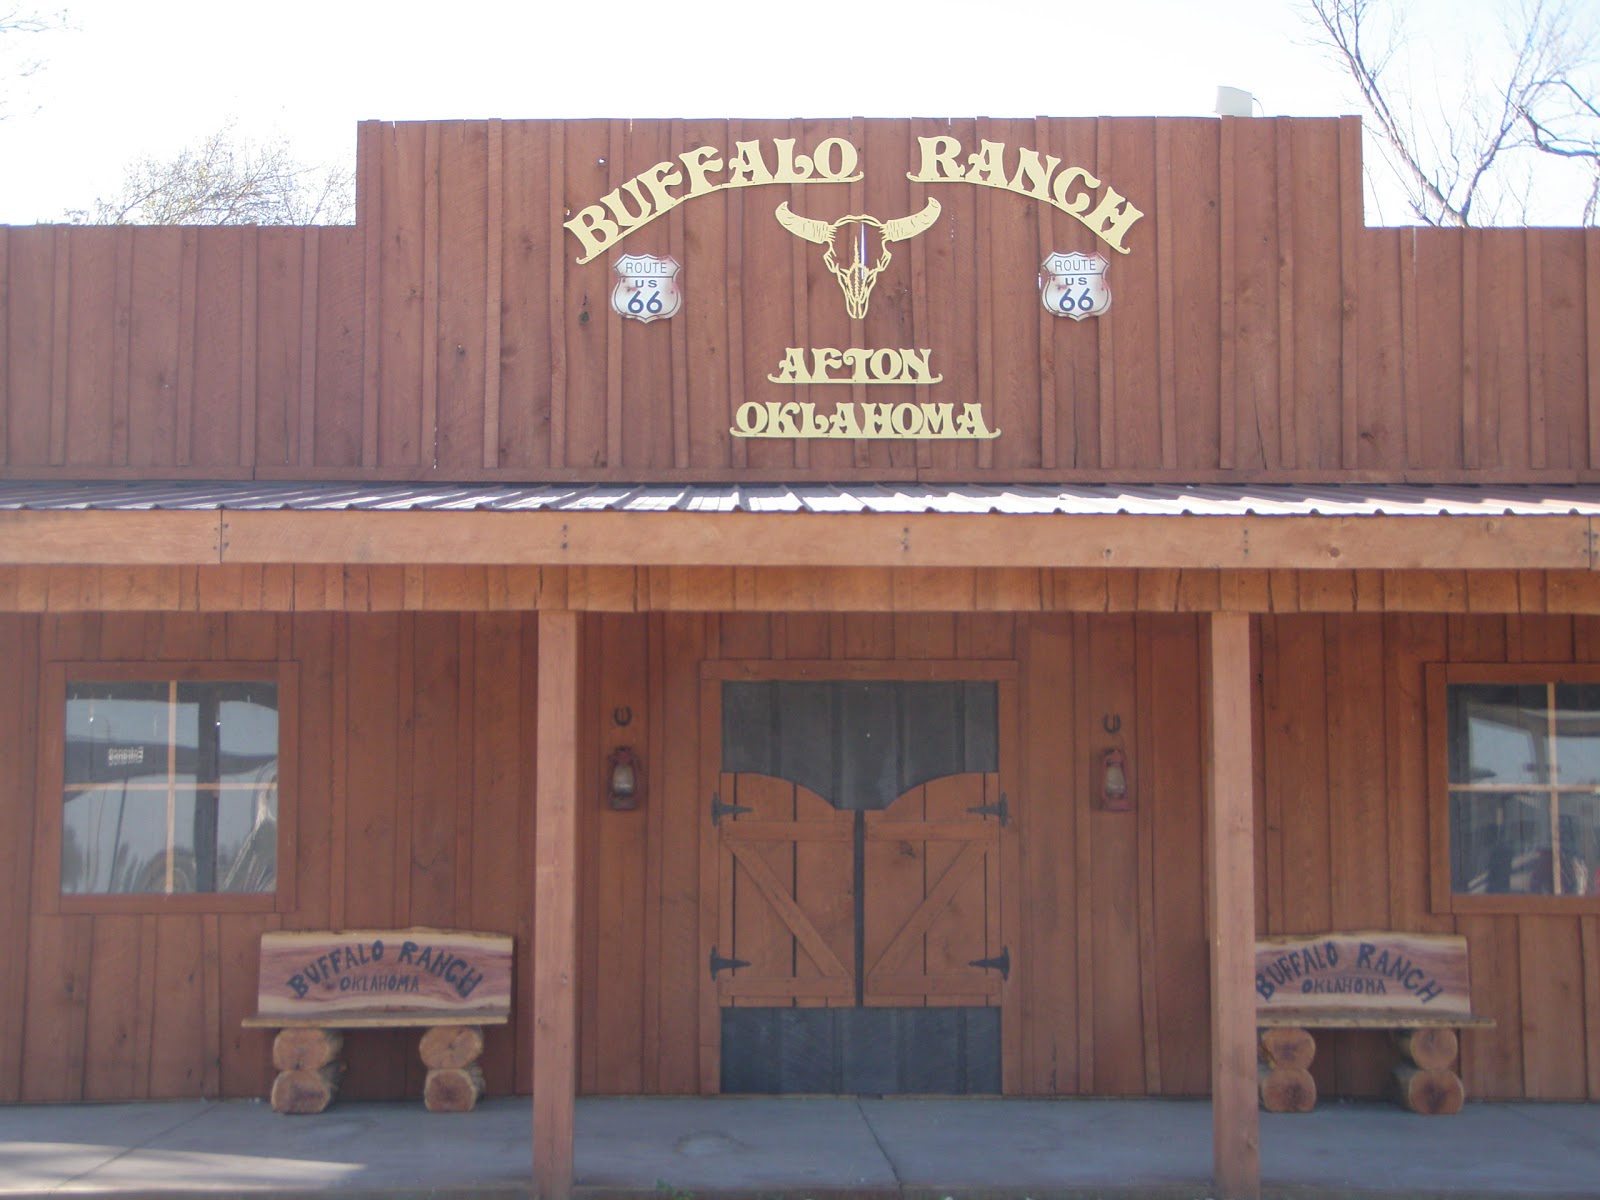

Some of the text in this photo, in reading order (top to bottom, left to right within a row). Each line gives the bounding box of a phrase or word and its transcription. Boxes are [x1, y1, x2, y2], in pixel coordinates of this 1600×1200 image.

[564, 136, 1143, 264] BUFFALO RANCH
[625, 262, 667, 273] ROUTE
[1054, 259, 1096, 271] ROUTE
[635, 279, 657, 288] US
[1065, 277, 1087, 286] US
[627, 290, 663, 314] 66
[1059, 287, 1094, 312] 66
[768, 347, 943, 384] AFTON
[730, 401, 1001, 439] OKLAHOMA
[287, 940, 483, 998] BUFFALO RANCH
[1255, 941, 1444, 1003] BUFFALO RANCH
[340, 973, 420, 993] OKLAHOMA
[1301, 976, 1387, 995] OKLAHOMA
